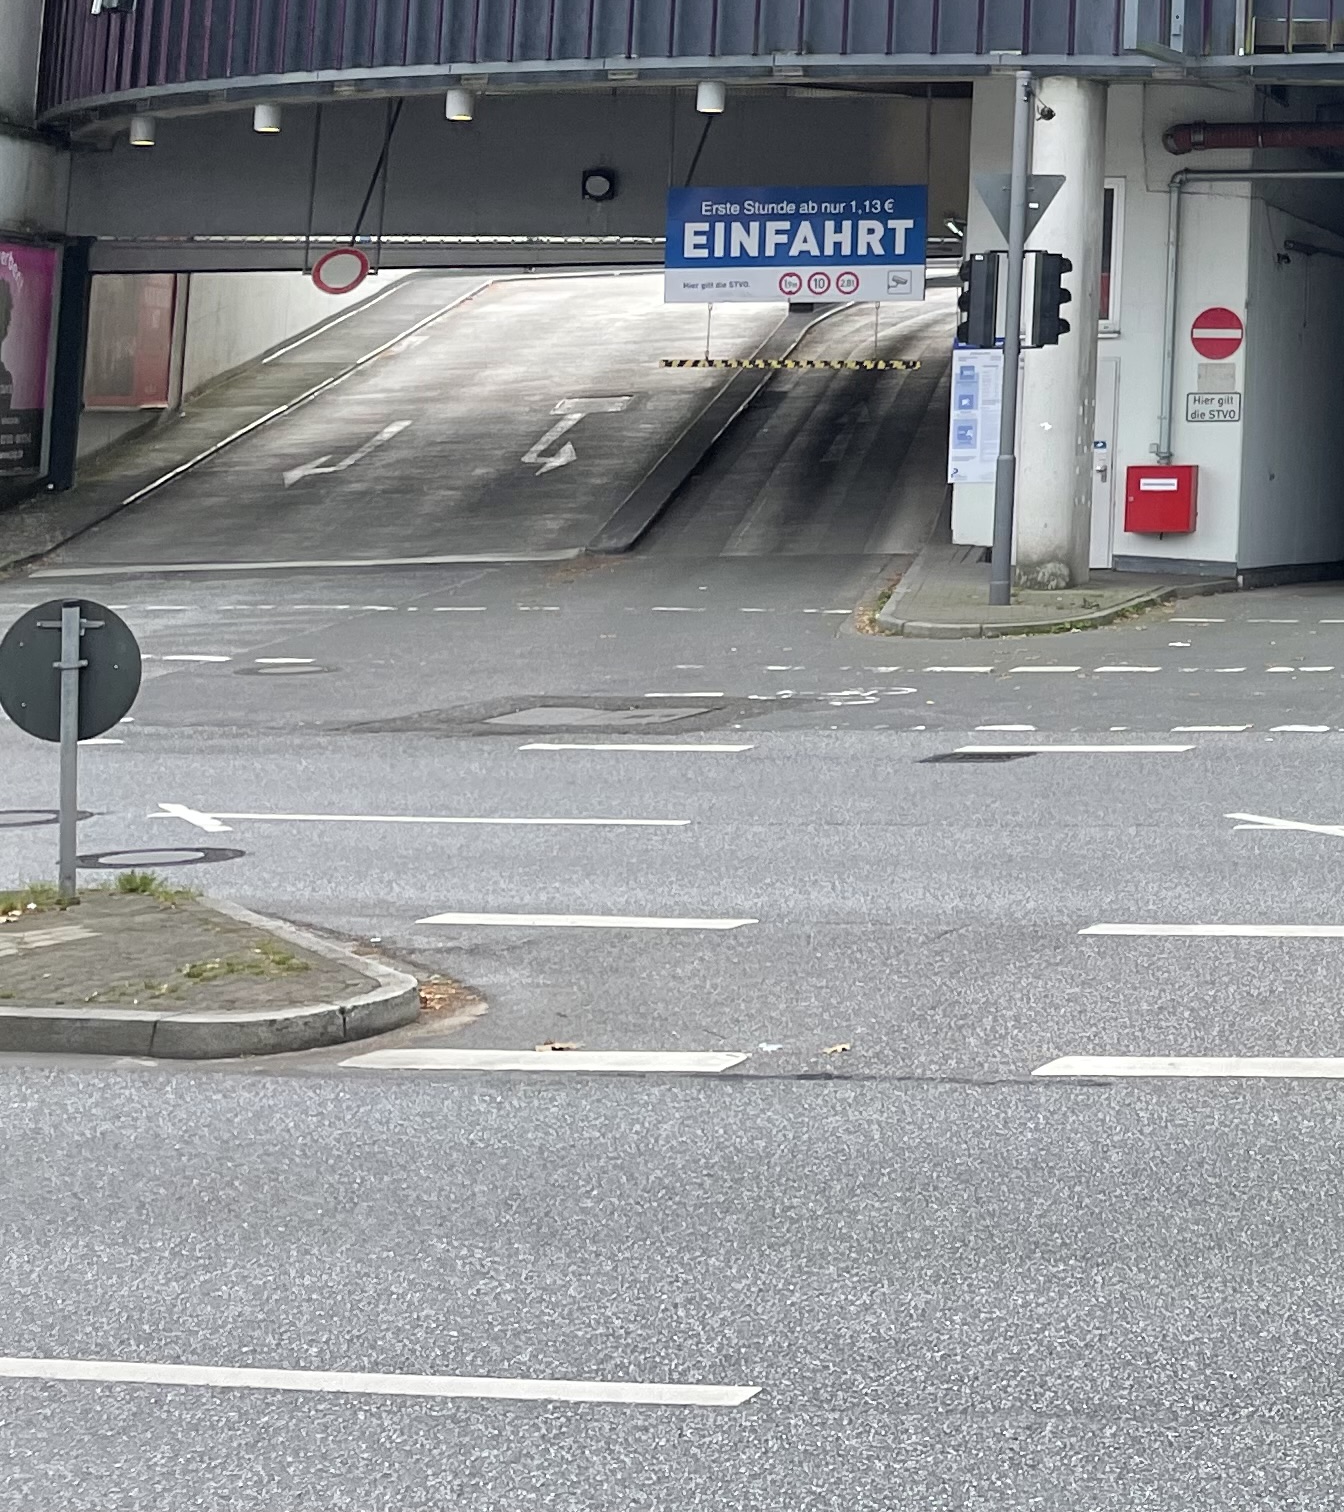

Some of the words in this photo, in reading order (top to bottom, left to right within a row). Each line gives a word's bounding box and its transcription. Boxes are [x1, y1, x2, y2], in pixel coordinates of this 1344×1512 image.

[701, 200, 740, 215] Erste
[744, 200, 796, 215] Stunde
[799, 199, 818, 214] ab
[822, 201, 846, 214] nur
[850, 199, 881, 215] 1,13
[884, 199, 895, 213] €
[683, 219, 914, 259] EINFAHRT
[813, 278, 826, 289] 10
[1193, 395, 1216, 405] Hier
[1218, 396, 1234, 407] gilt
[1190, 409, 1206, 420] die
[1208, 409, 1236, 420] STVO
